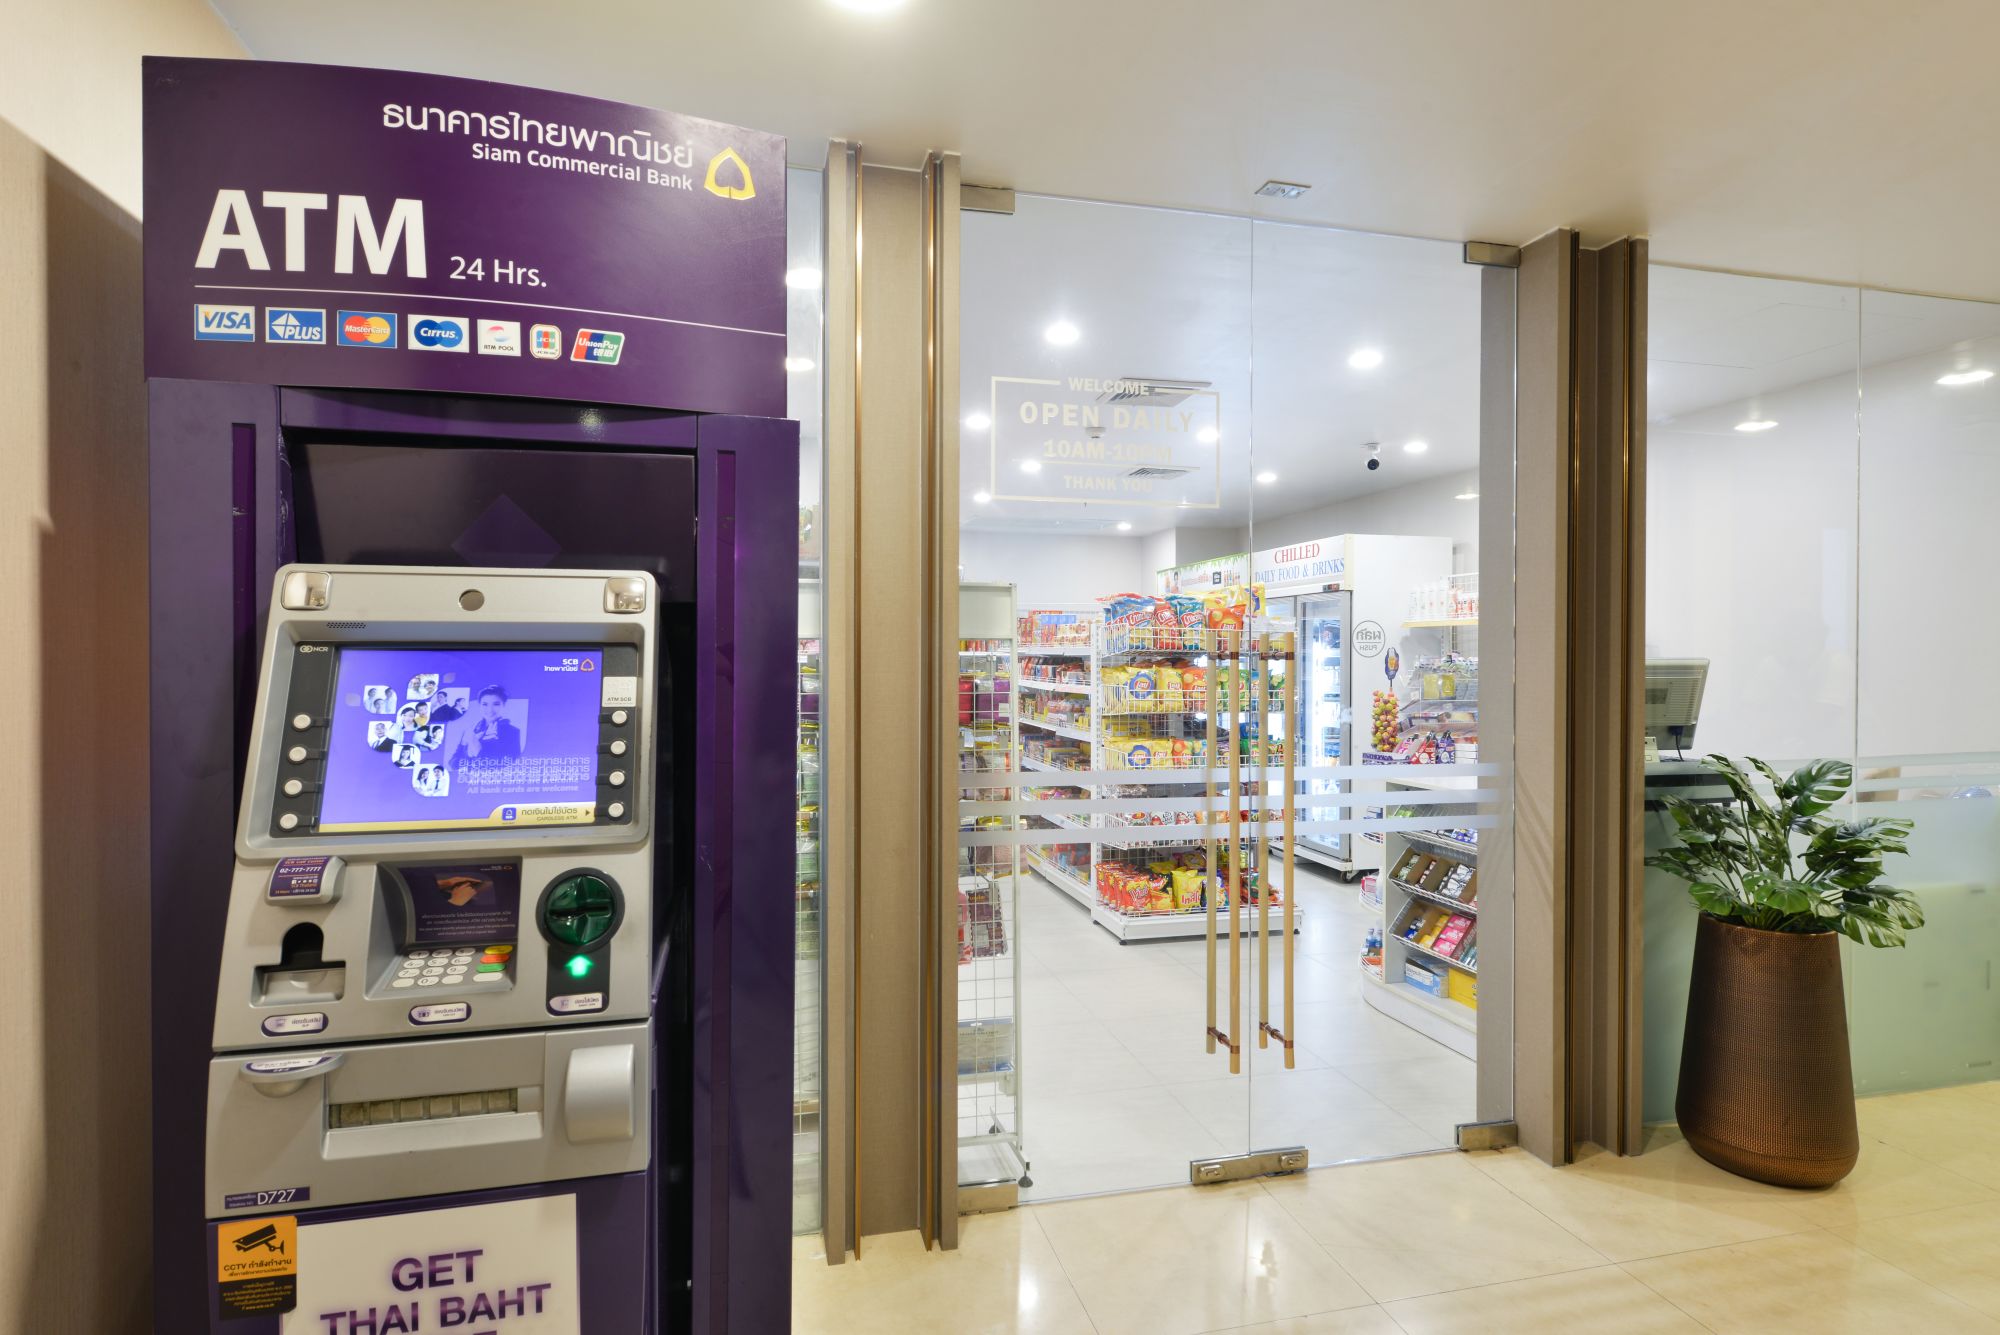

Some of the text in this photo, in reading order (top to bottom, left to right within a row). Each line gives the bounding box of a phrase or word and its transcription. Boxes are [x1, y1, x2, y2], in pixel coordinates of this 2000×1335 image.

[382, 103, 693, 169] ธนาคารไทยพาณิชย์
[472, 142, 693, 191] Siam Commercial Bank
[194, 189, 428, 278] ATM
[449, 255, 547, 288] 24 Hrs.
[202, 311, 252, 330] VISA
[344, 324, 391, 335] MasterCard
[284, 325, 321, 341] PLUS
[419, 327, 457, 338] Cirrus
[578, 337, 619, 351] UnionPay
[1067, 377, 1150, 396] WELCOME
[1019, 401, 1194, 433] OPEN DAILY
[1064, 475, 1153, 494] THANK YOU
[1274, 543, 1320, 564] CHILLED
[1255, 569, 1276, 583] DAILY
[1278, 565, 1300, 581] FOOD
[1312, 558, 1345, 576] DRINKS
[257, 1189, 296, 1205] D727
[223, 1263, 247, 1272] CCTV
[391, 1249, 484, 1293] GET
[320, 1282, 552, 1335] THAI BAHT
